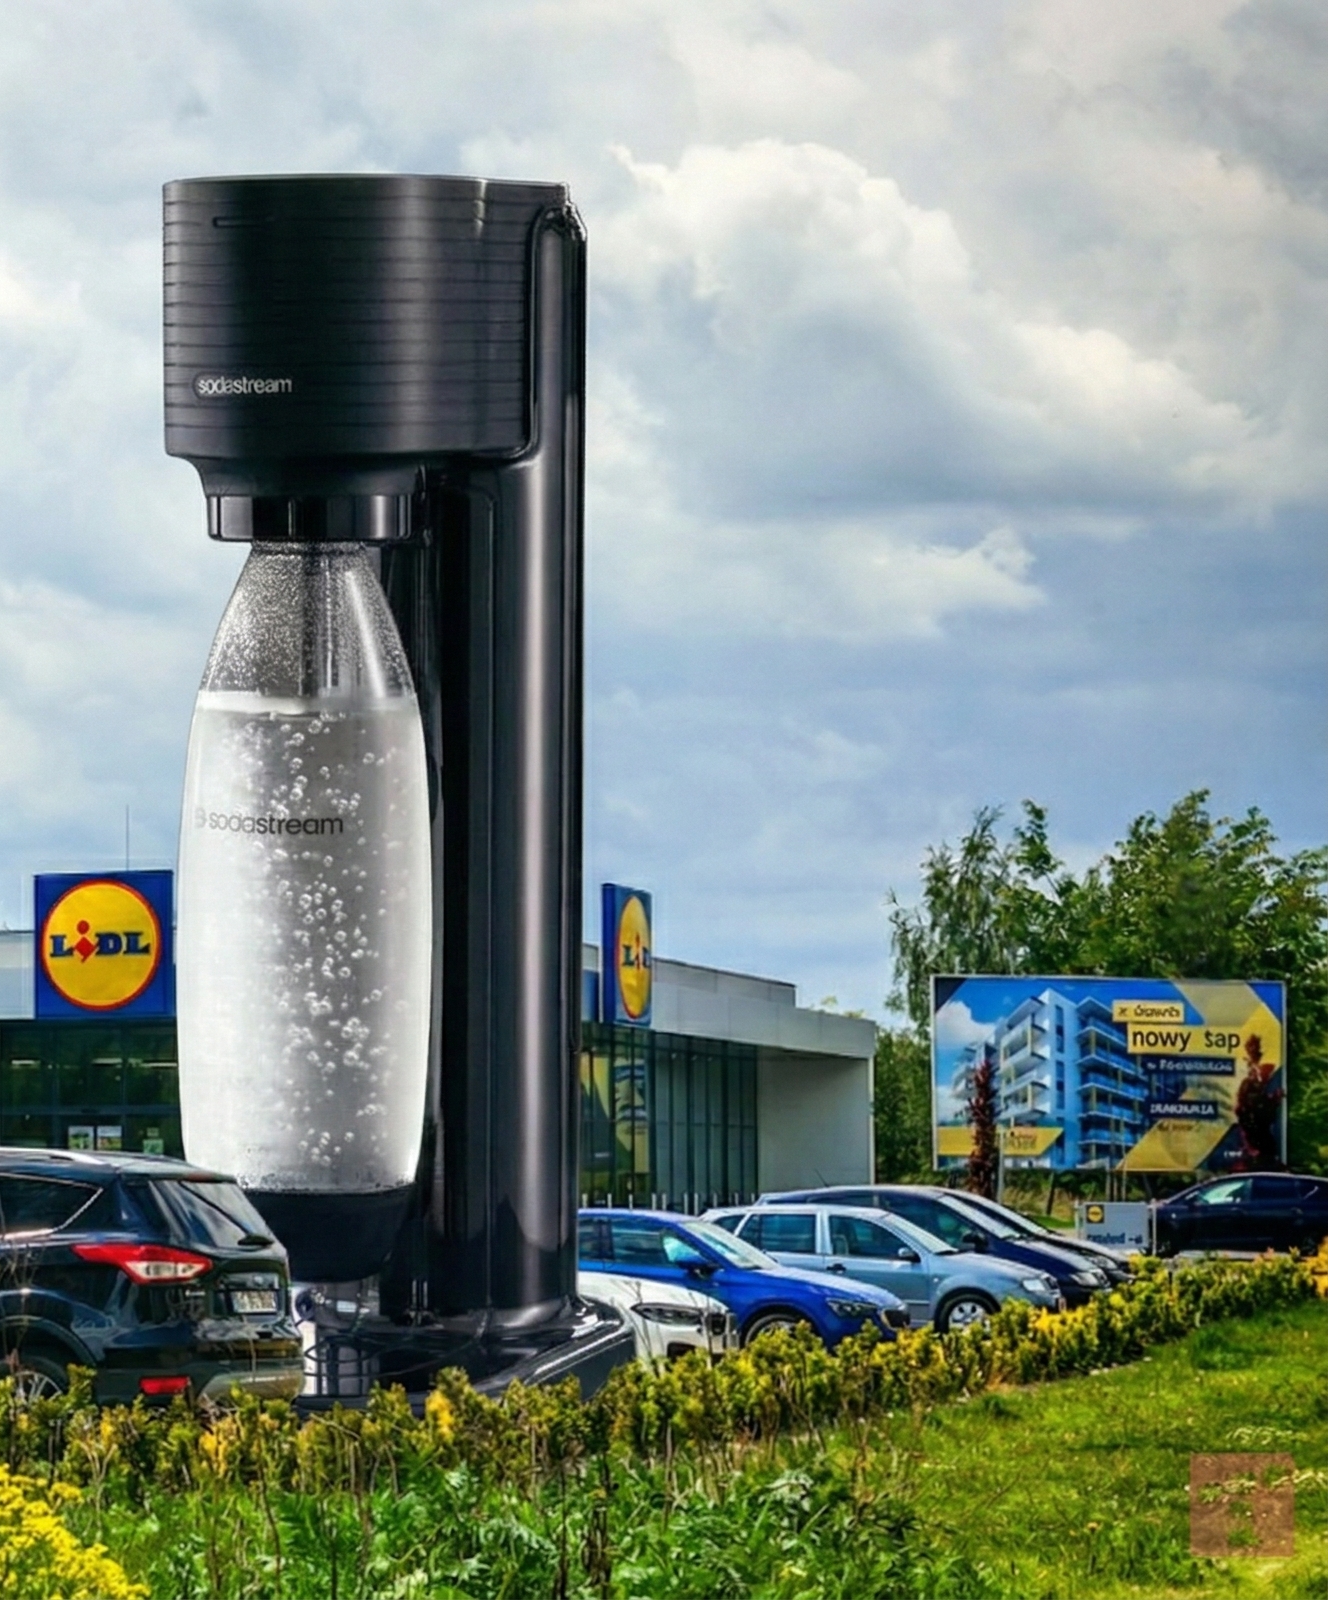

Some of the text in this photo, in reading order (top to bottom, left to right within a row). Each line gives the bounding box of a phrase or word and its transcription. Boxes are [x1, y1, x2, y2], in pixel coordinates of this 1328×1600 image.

[197, 376, 292, 395] sodastream
[208, 812, 344, 835] sodastream
[1132, 1031, 1191, 1052] nowy
